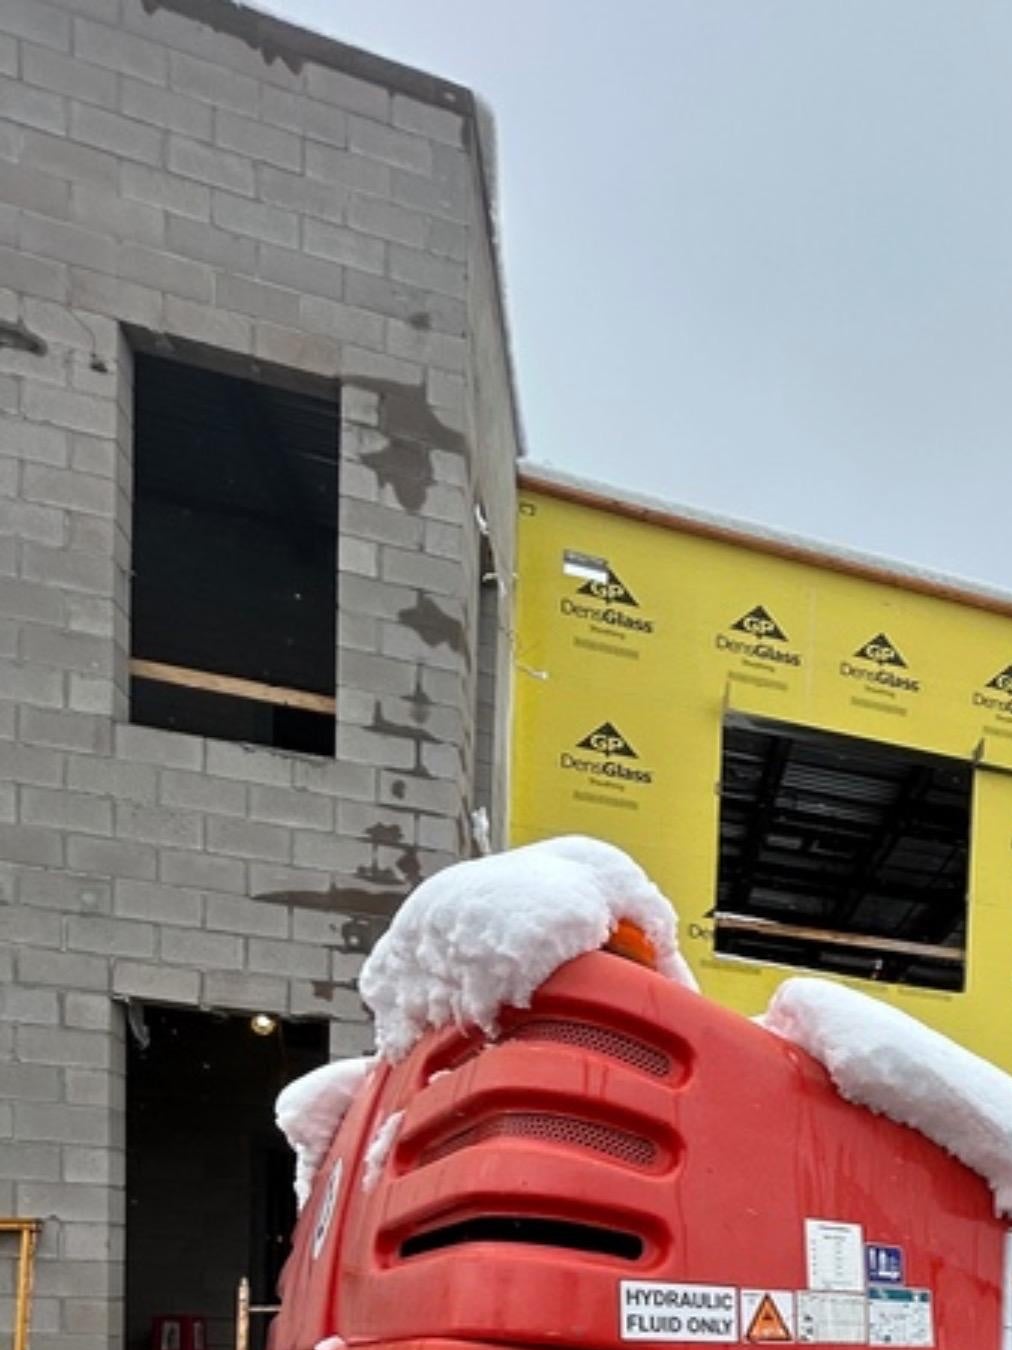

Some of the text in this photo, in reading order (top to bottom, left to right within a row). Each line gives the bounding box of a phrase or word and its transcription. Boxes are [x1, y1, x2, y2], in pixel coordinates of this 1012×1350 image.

[560, 597, 654, 634] DensGlass
[715, 633, 801, 667] DensGlass
[839, 661, 921, 693] DensGlass
[560, 752, 653, 784] DensGlass
[626, 1287, 733, 1311] HYDRAULIC
[626, 1313, 733, 1336] FLUID ONLY
